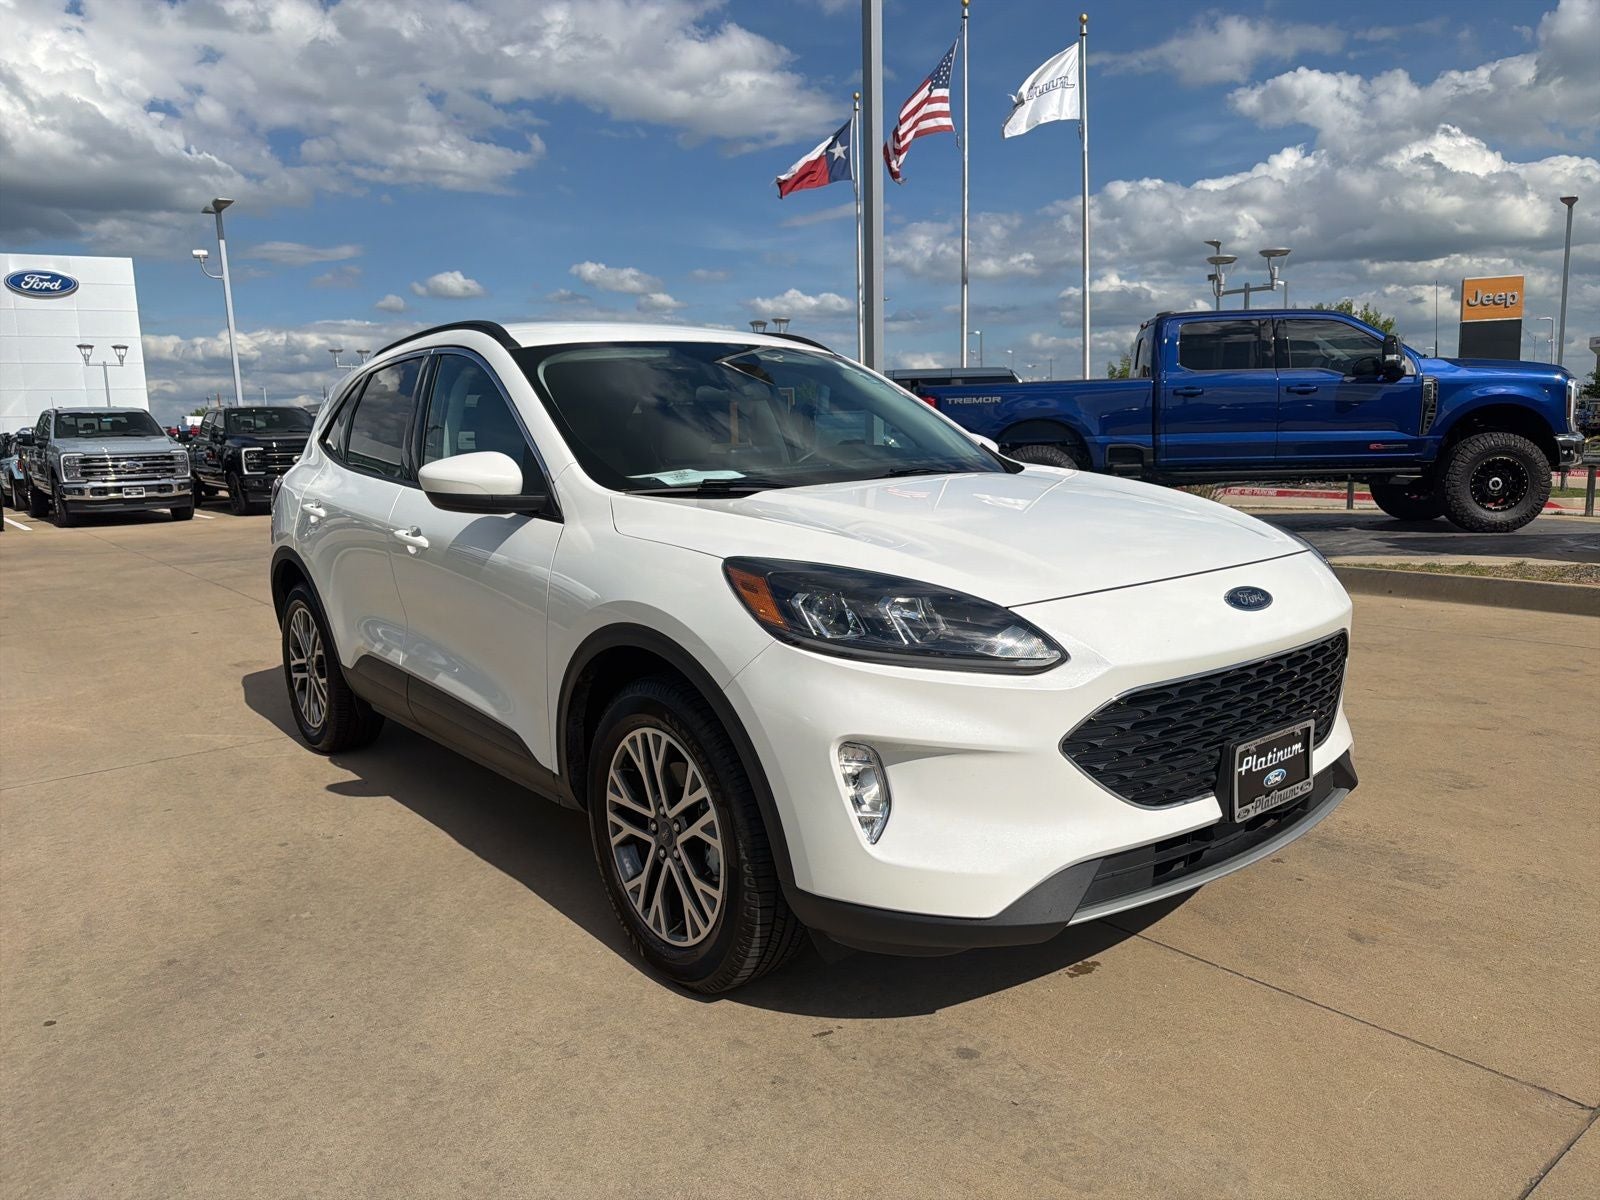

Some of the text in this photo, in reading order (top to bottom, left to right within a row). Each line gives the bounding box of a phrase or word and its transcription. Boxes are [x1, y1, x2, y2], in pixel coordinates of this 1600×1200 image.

[21, 274, 62, 290] Ford
[1467, 289, 1519, 308] Jeep
[945, 396, 1002, 405] TREMOR
[1253, 489, 1277, 497] PARKING
[1237, 590, 1265, 606] Ford
[1237, 742, 1305, 776] Platinum
[1267, 771, 1283, 786] Ford
[1254, 787, 1299, 813] Platinum
